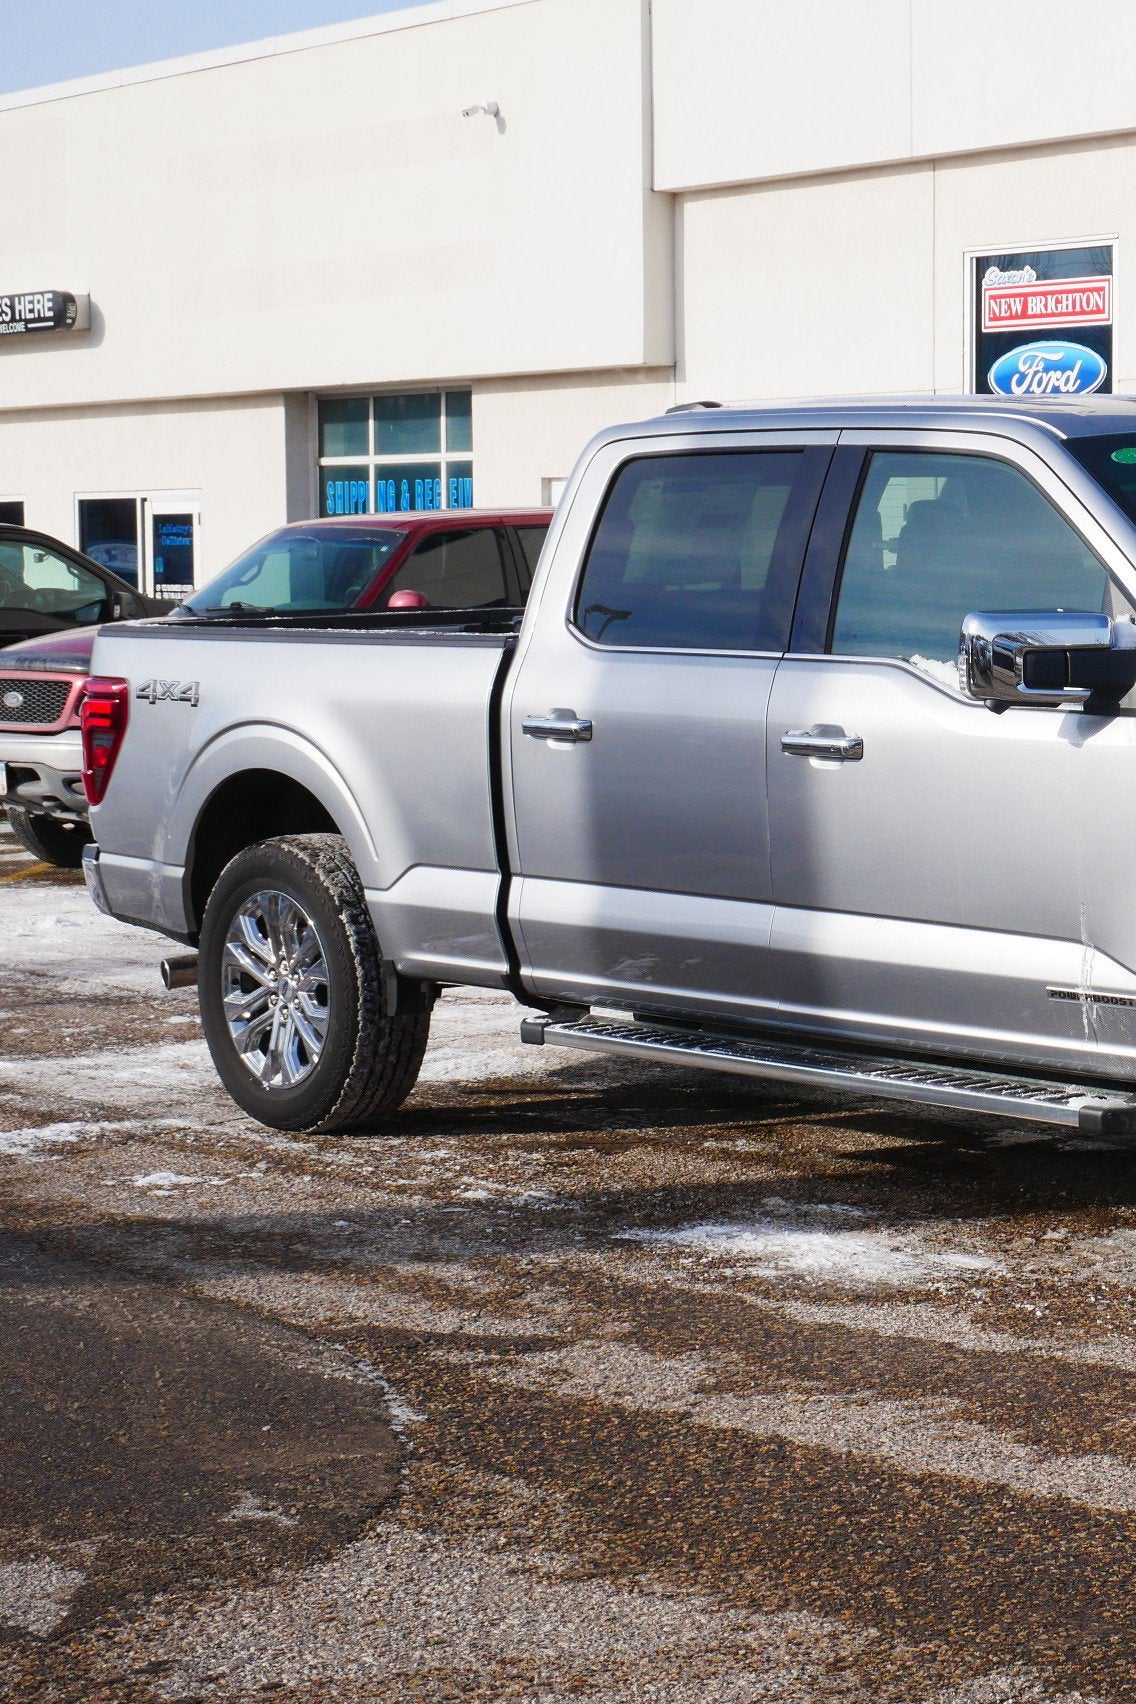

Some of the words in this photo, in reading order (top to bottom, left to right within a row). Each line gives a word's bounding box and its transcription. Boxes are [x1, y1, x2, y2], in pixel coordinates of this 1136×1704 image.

[15, 293, 54, 320] HERE
[989, 297, 1024, 317] NEW
[1027, 291, 1104, 315] BRIGHTON
[1011, 350, 1083, 394] Ford
[400, 479, 410, 511] &
